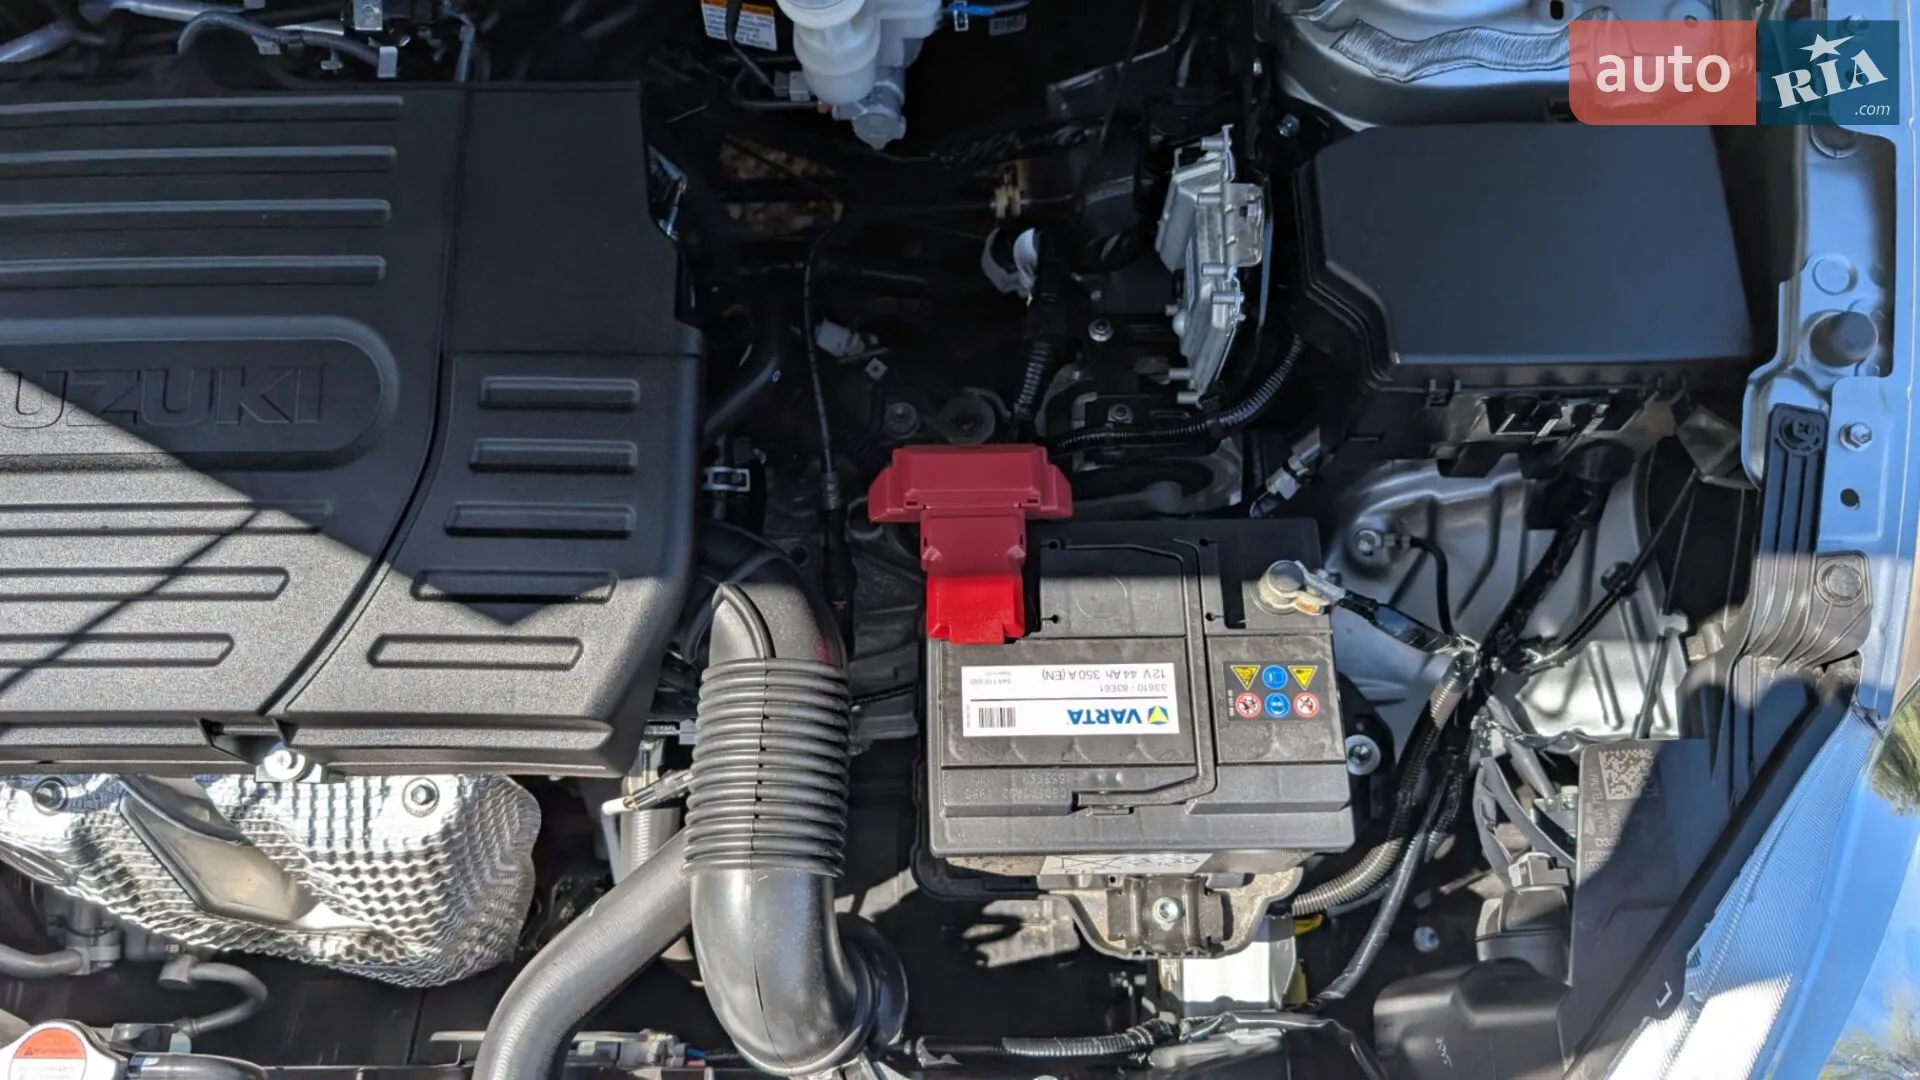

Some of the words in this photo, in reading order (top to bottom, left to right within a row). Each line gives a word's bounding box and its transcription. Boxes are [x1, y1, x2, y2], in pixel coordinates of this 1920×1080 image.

[1042, 669, 1066, 681] (EN)
[1078, 670, 1100, 680] 350
[1106, 669, 1121, 679] Ah
[1123, 669, 1137, 679] 44
[1138, 683, 1167, 692] 33610
[1067, 708, 1143, 725] VARTA
